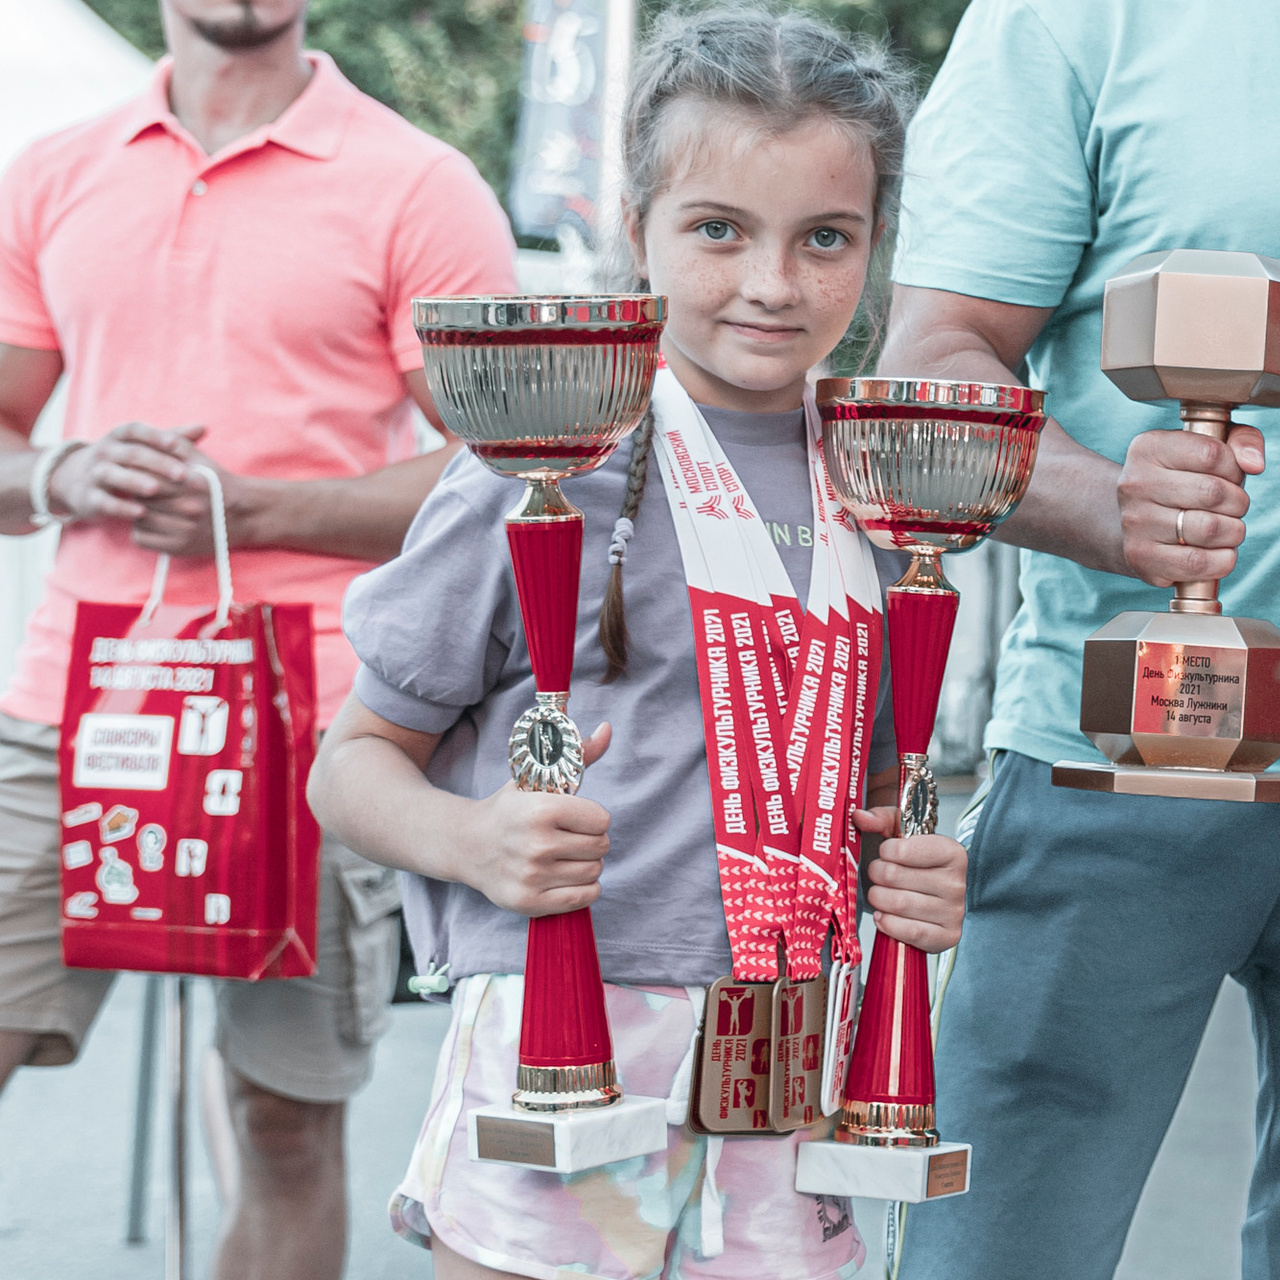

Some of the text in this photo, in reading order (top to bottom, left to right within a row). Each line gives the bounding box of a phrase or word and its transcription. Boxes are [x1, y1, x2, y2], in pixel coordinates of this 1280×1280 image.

[663, 430, 703, 494] МОСКОВСКИЙ
[696, 461, 719, 492] СПОРТ
[730, 612, 754, 648] 2021
[774, 608, 800, 644] 2021
[856, 622, 869, 657] 2021
[805, 638, 827, 675] 2021
[1182, 655, 1211, 668] МЕСТО
[1142, 666, 1240, 684] День Физкультурника
[1179, 683, 1201, 695] 2021
[1150, 695, 1228, 711] Москва Лужники
[1165, 710, 1212, 725] 14 августа
[703, 608, 747, 834] ДЕНЬ ФИЗКУЛЬТУРНИКА 2021
[738, 650, 780, 792] ФИЗКУЛЬТУРНИКА
[849, 660, 868, 800] ФИЗКУЛЬТУРНИКА
[812, 634, 851, 855] ДЕНЬ ФИЗКУЛЬТУРНИКА 2021
[766, 794, 789, 835] ДЕНЬ
[711, 1039, 722, 1062] ДЕНЬ
[735, 1038, 748, 1062] 2021
[792, 1037, 800, 1059] 2021
[719, 1038, 734, 1119] ФИЗКУЛЬТУРНИКА
